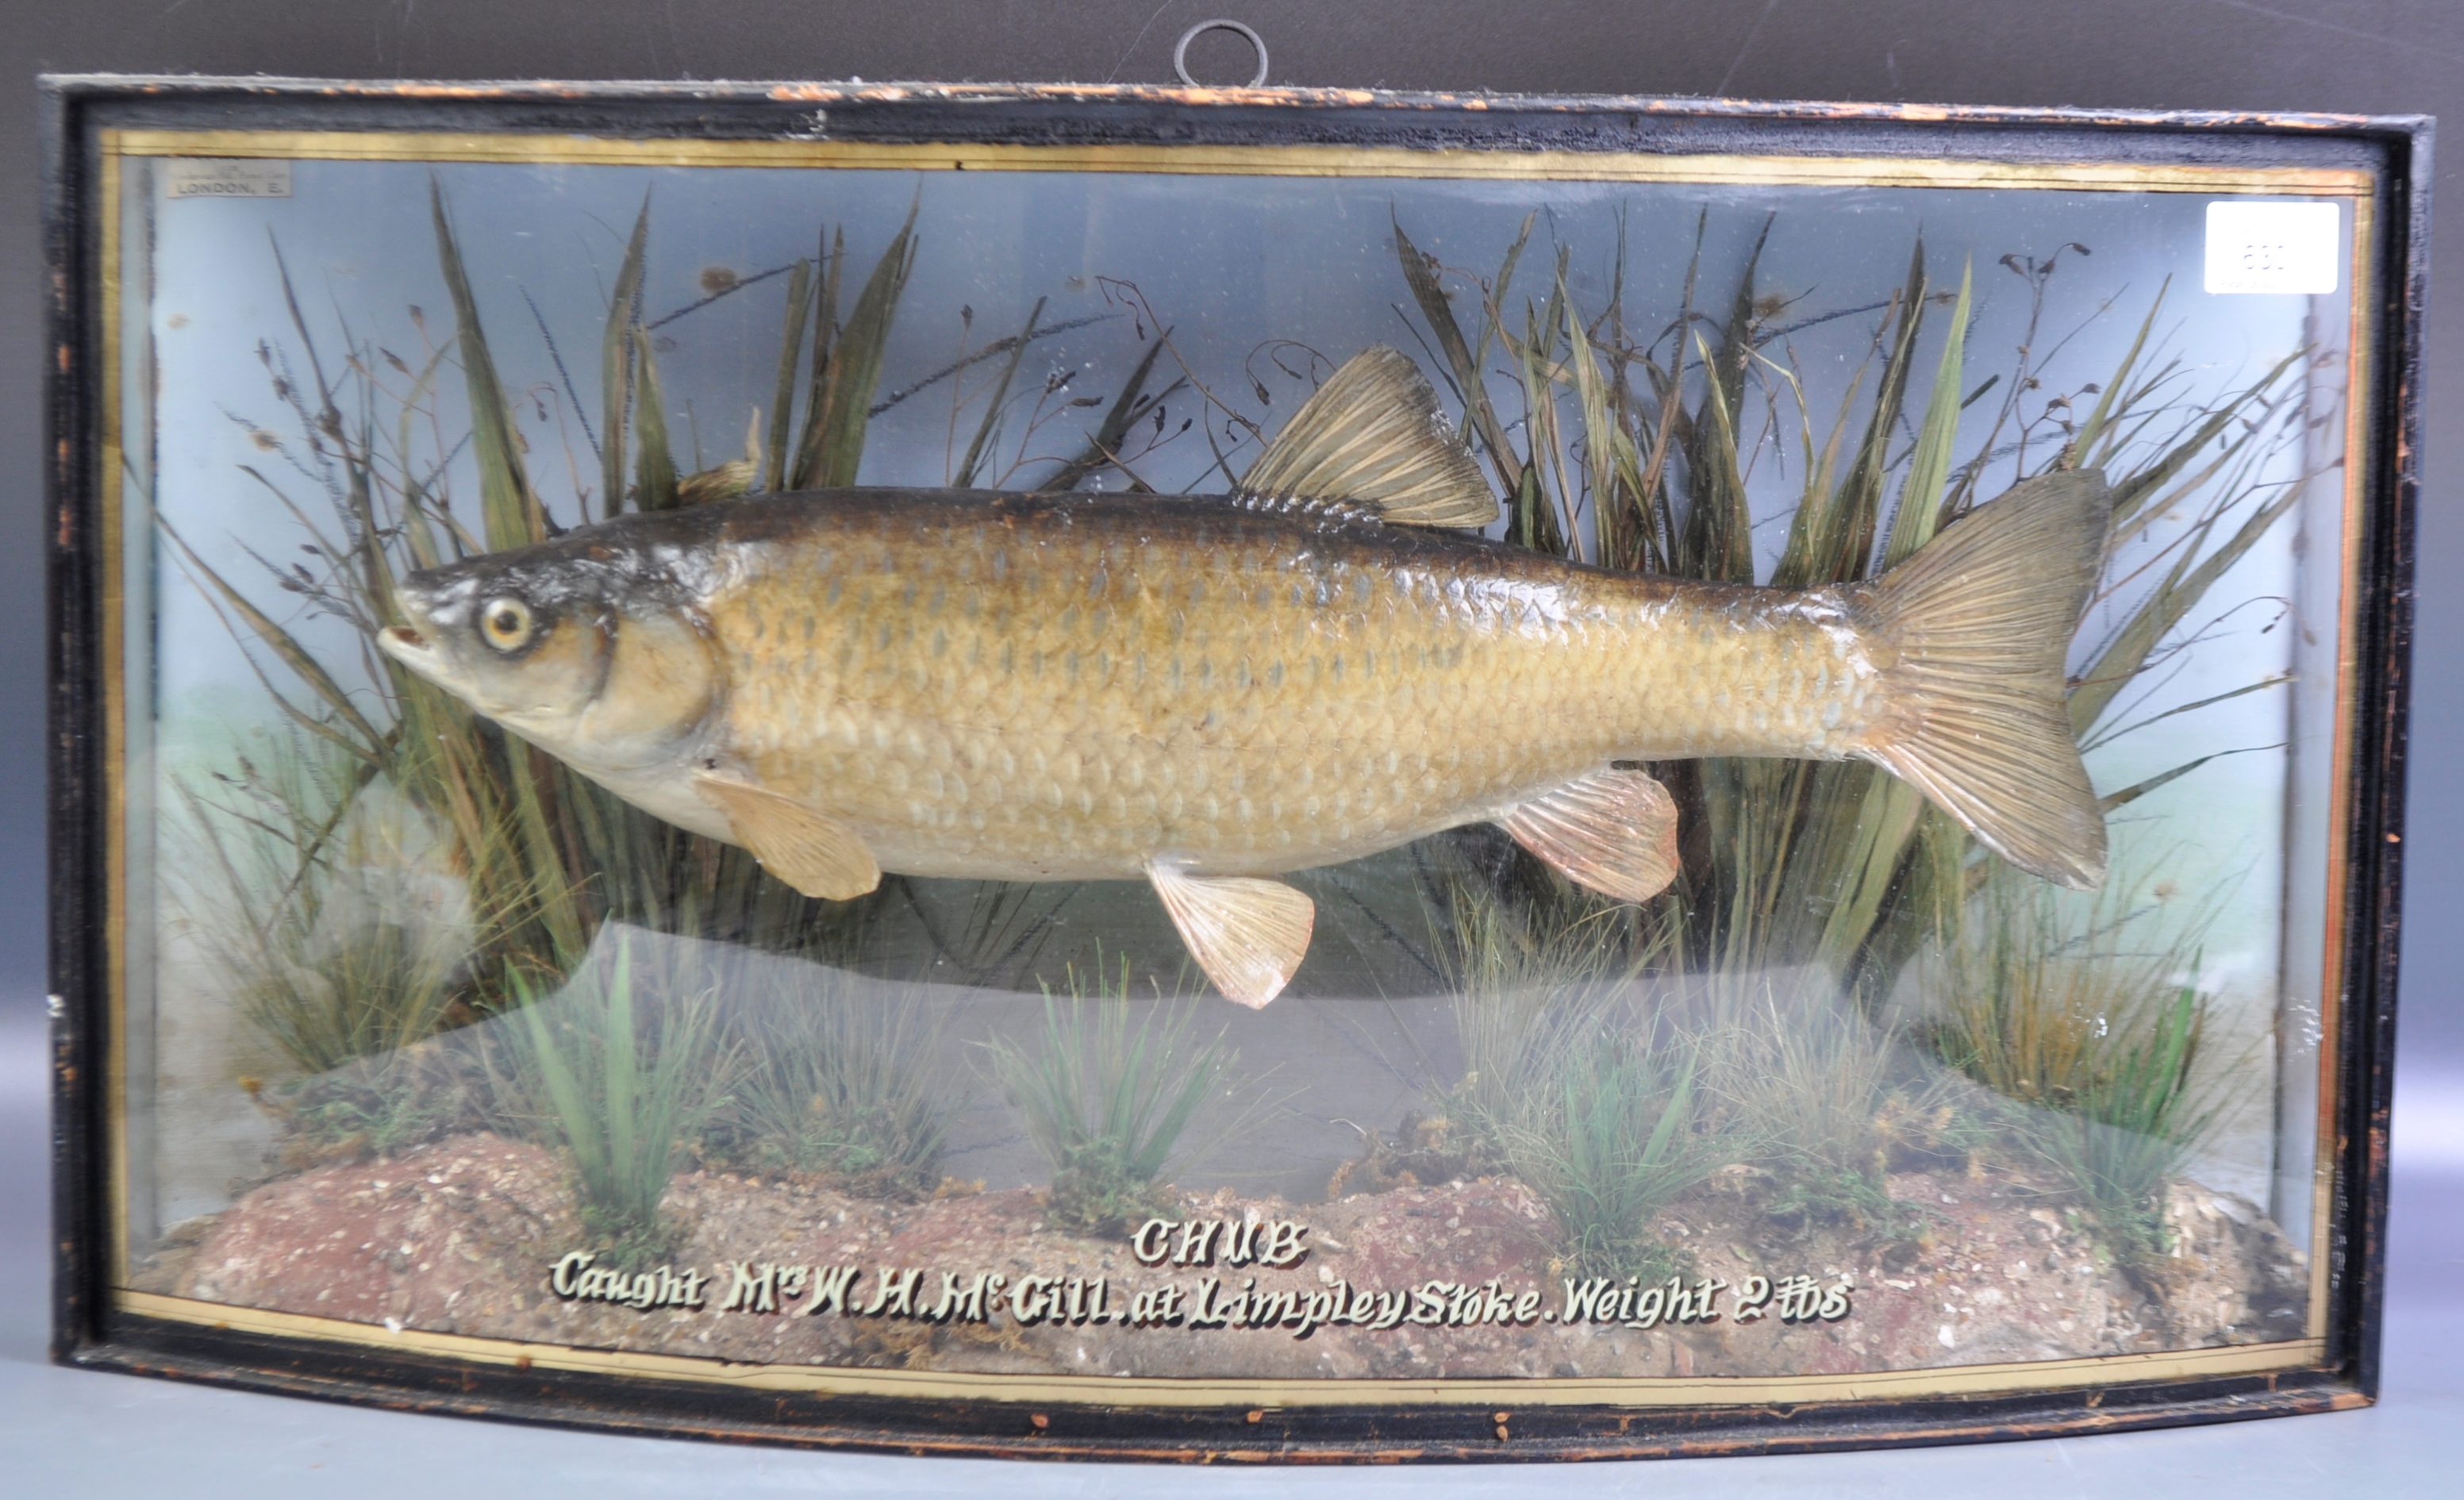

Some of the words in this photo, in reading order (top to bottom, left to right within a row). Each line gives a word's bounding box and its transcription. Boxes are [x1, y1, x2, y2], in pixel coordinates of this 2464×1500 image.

[177, 183, 256, 195] LONDON,
[267, 183, 284, 194] E.
[1131, 1218, 1310, 1269] CHUB
[549, 1249, 710, 1312] Caught
[1190, 1275, 1410, 1340] Limpley
[1563, 1275, 1730, 1329] Weight
[1733, 1275, 1774, 1325] 2
